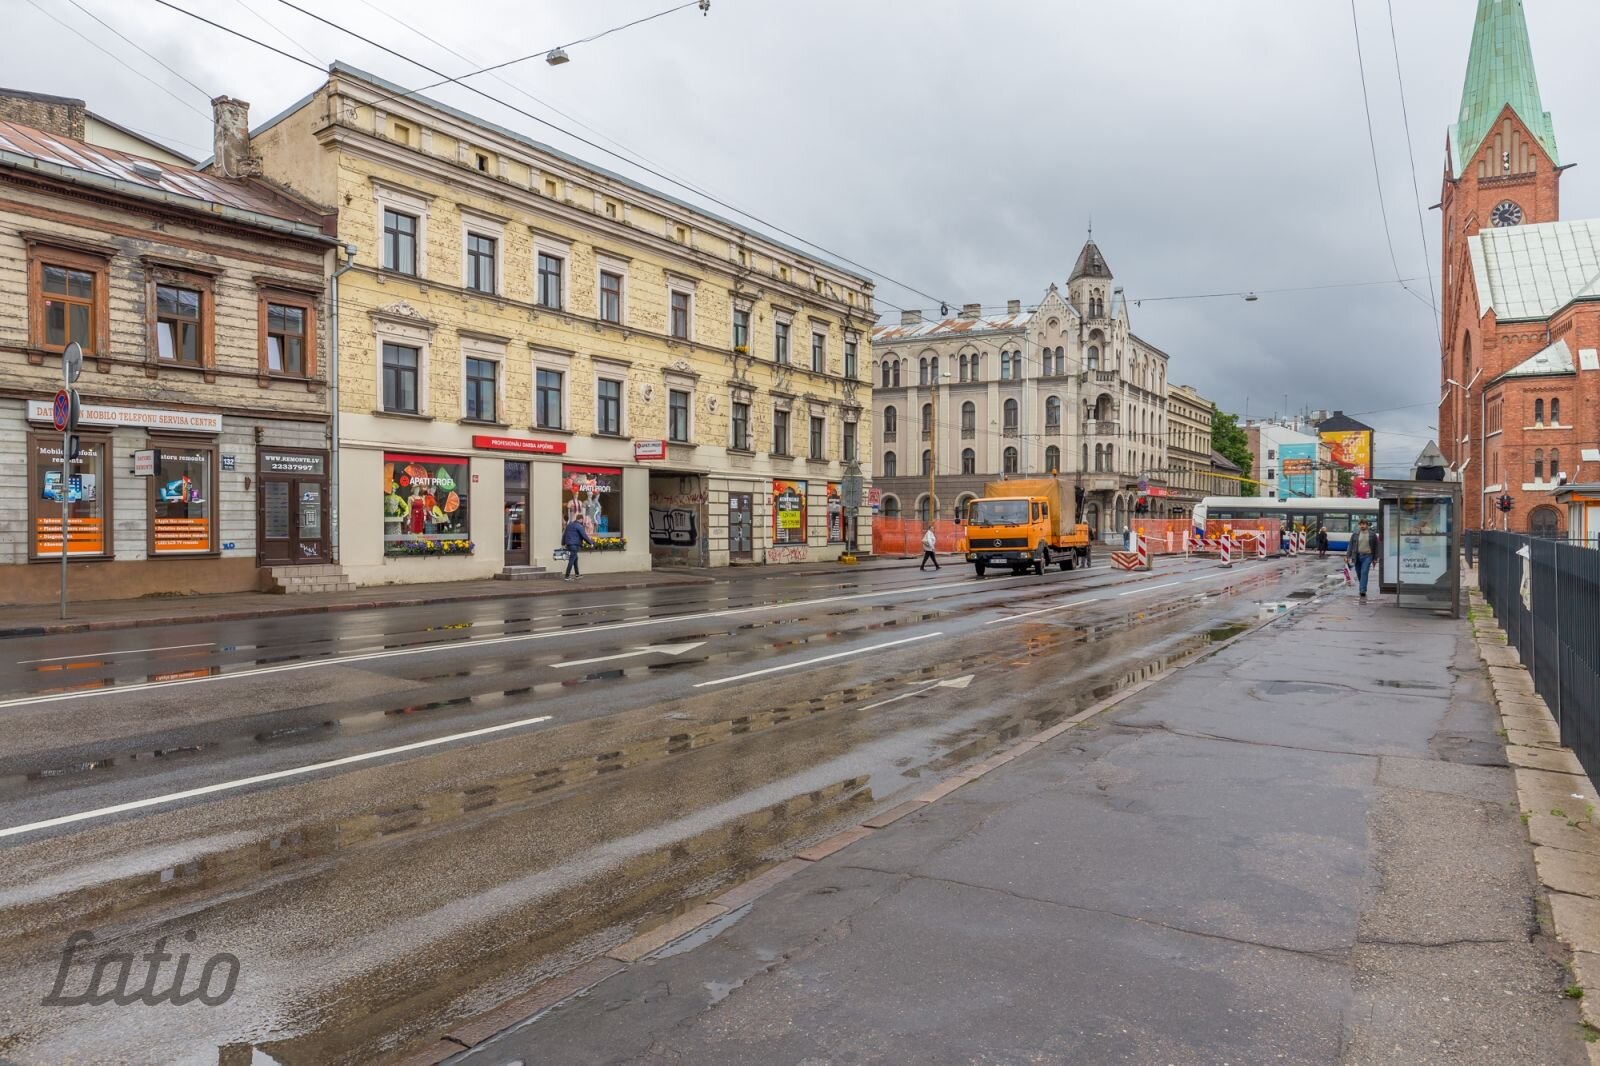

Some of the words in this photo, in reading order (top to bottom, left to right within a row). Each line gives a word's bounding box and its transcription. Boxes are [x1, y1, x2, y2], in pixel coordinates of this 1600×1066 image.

[86, 410, 116, 420] MOBILO
[119, 412, 157, 424] TELEFONU
[159, 415, 188, 425] SERVISA
[190, 417, 217, 427] CENTRS
[271, 463, 313, 471] 22337997
[409, 476, 430, 486] APATI
[431, 478, 454, 486] PROFI
